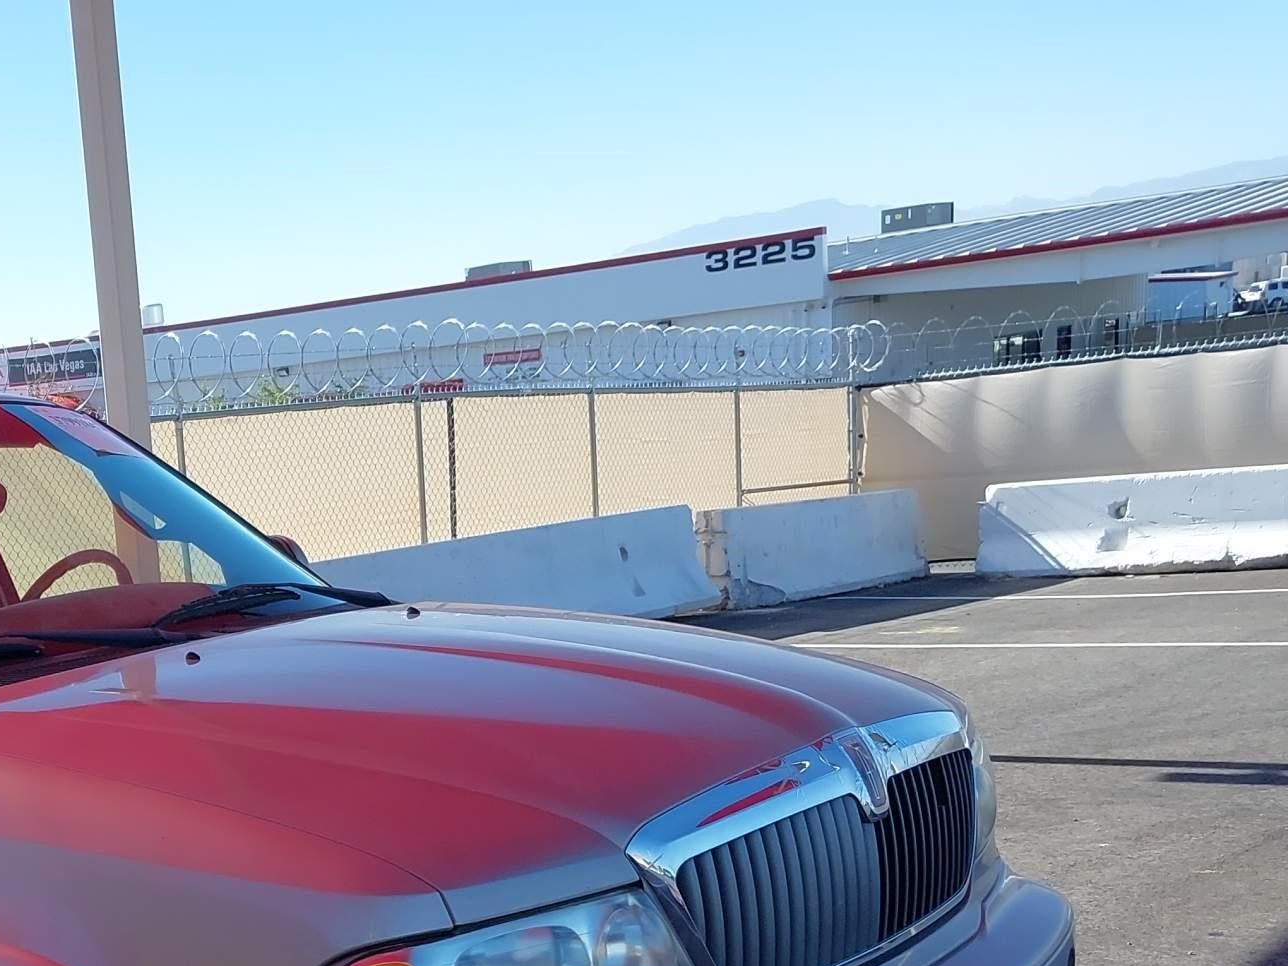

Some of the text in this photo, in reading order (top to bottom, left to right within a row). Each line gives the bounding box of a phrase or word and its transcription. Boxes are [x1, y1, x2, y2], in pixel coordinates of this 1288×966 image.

[705, 236, 816, 273] 3225
[27, 363, 42, 376] IAA
[59, 359, 85, 373] Vegas
